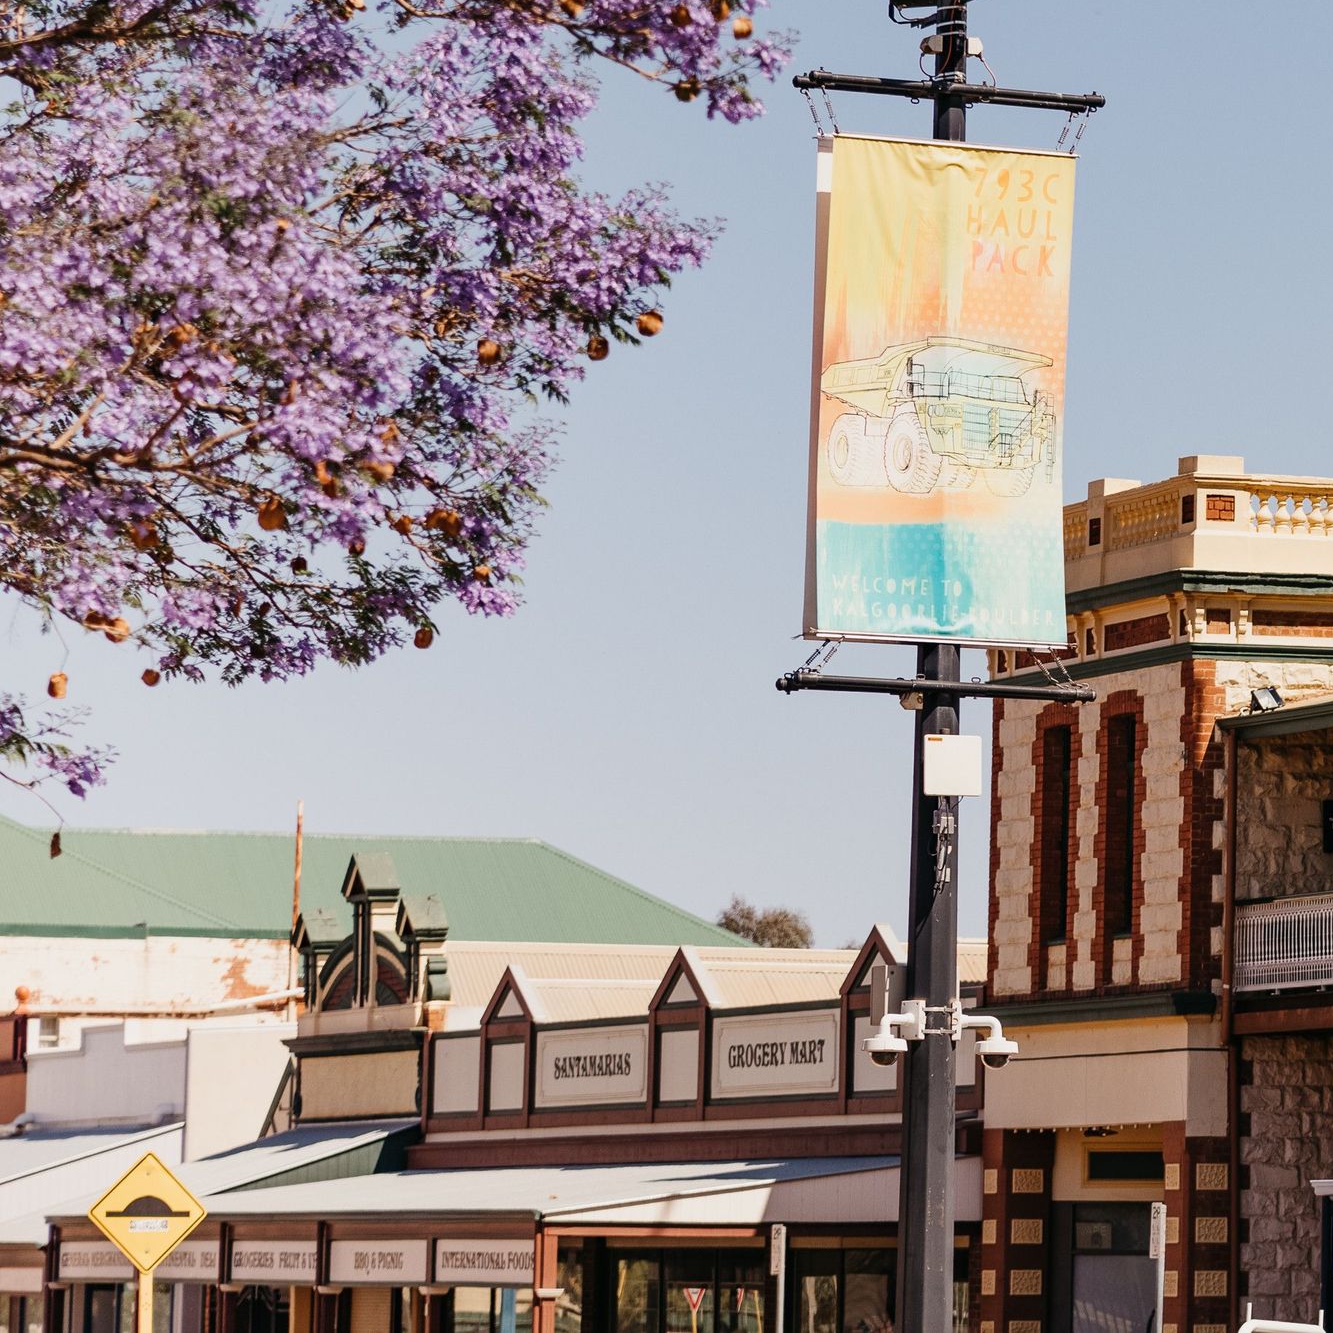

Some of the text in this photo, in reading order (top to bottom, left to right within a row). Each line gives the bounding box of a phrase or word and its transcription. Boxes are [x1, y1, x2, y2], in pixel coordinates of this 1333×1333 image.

[975, 167, 1060, 205] 793C
[966, 202, 1057, 241] HAUL
[971, 239, 1055, 277] PACK
[832, 574, 963, 597] WELCOME TO
[554, 1053, 631, 1079] SANTAMARIAS
[728, 1039, 826, 1069] GROCERY MART
[441, 1251, 505, 1271] INTERNATIONAL
